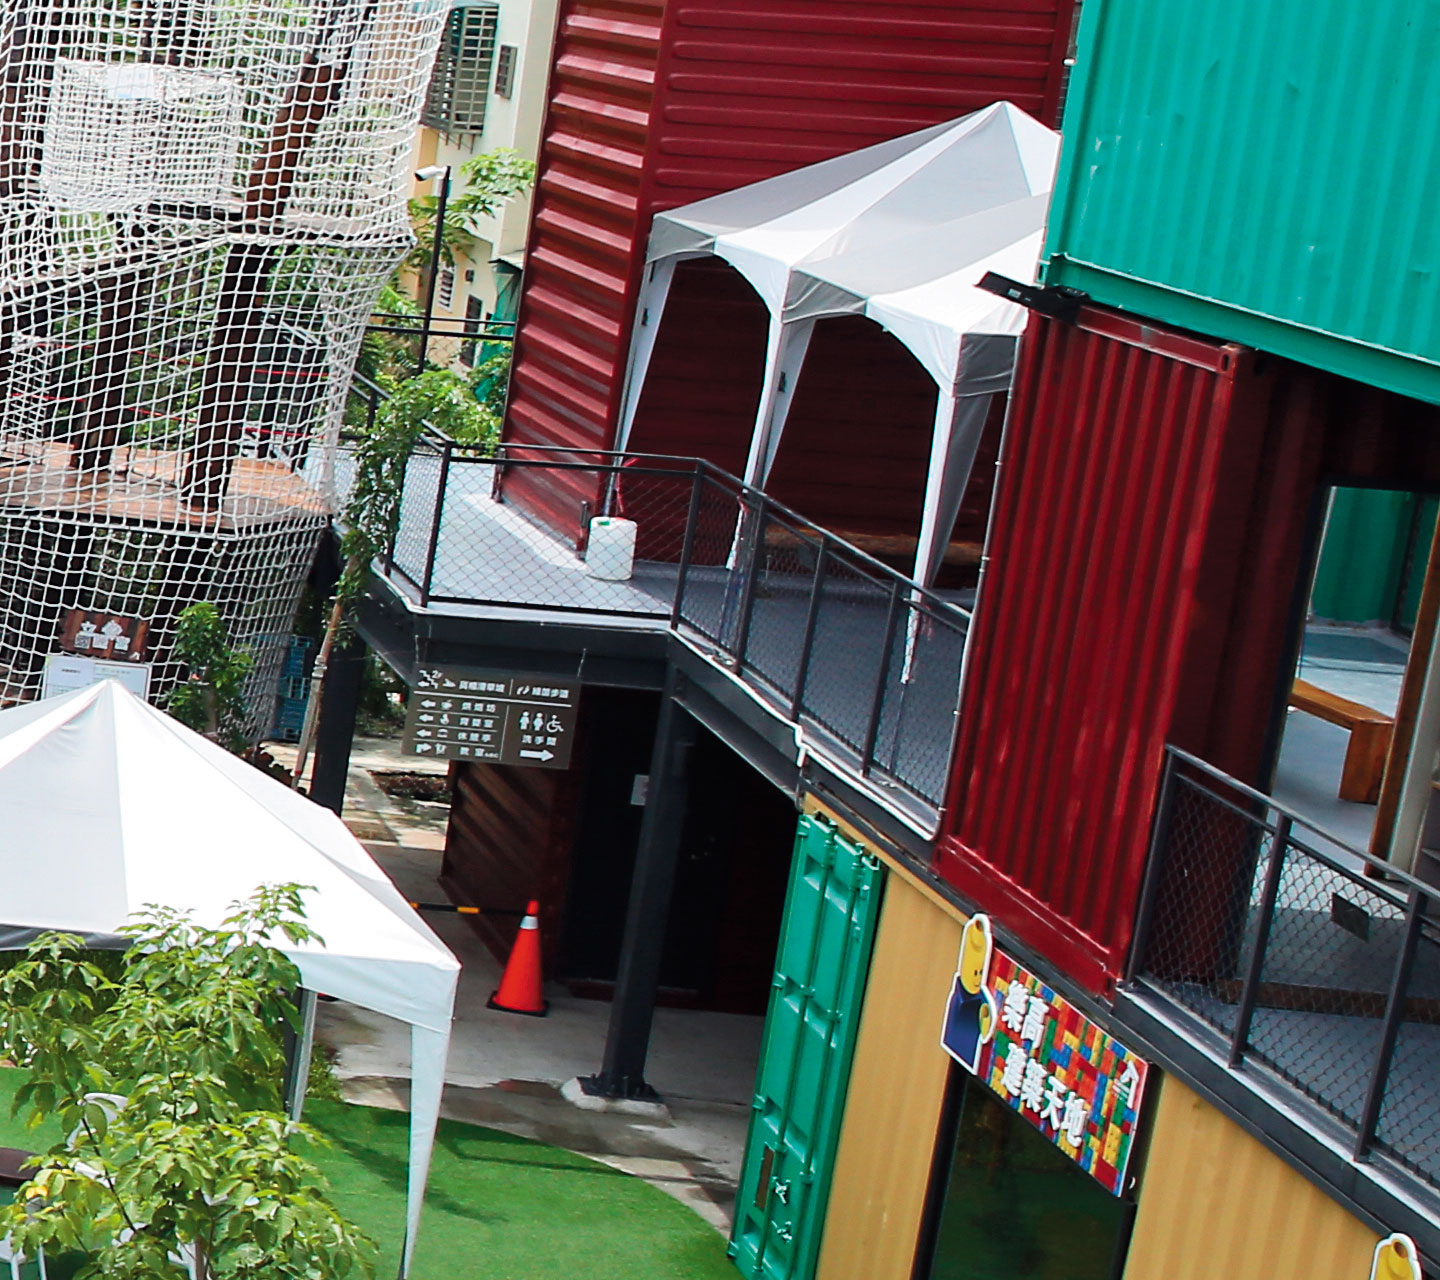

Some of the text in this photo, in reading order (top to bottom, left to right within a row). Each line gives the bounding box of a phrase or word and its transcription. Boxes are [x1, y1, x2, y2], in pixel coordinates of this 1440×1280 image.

[1002, 979, 1050, 1050] 樂高
[1000, 1042, 1090, 1148] 建築天地
